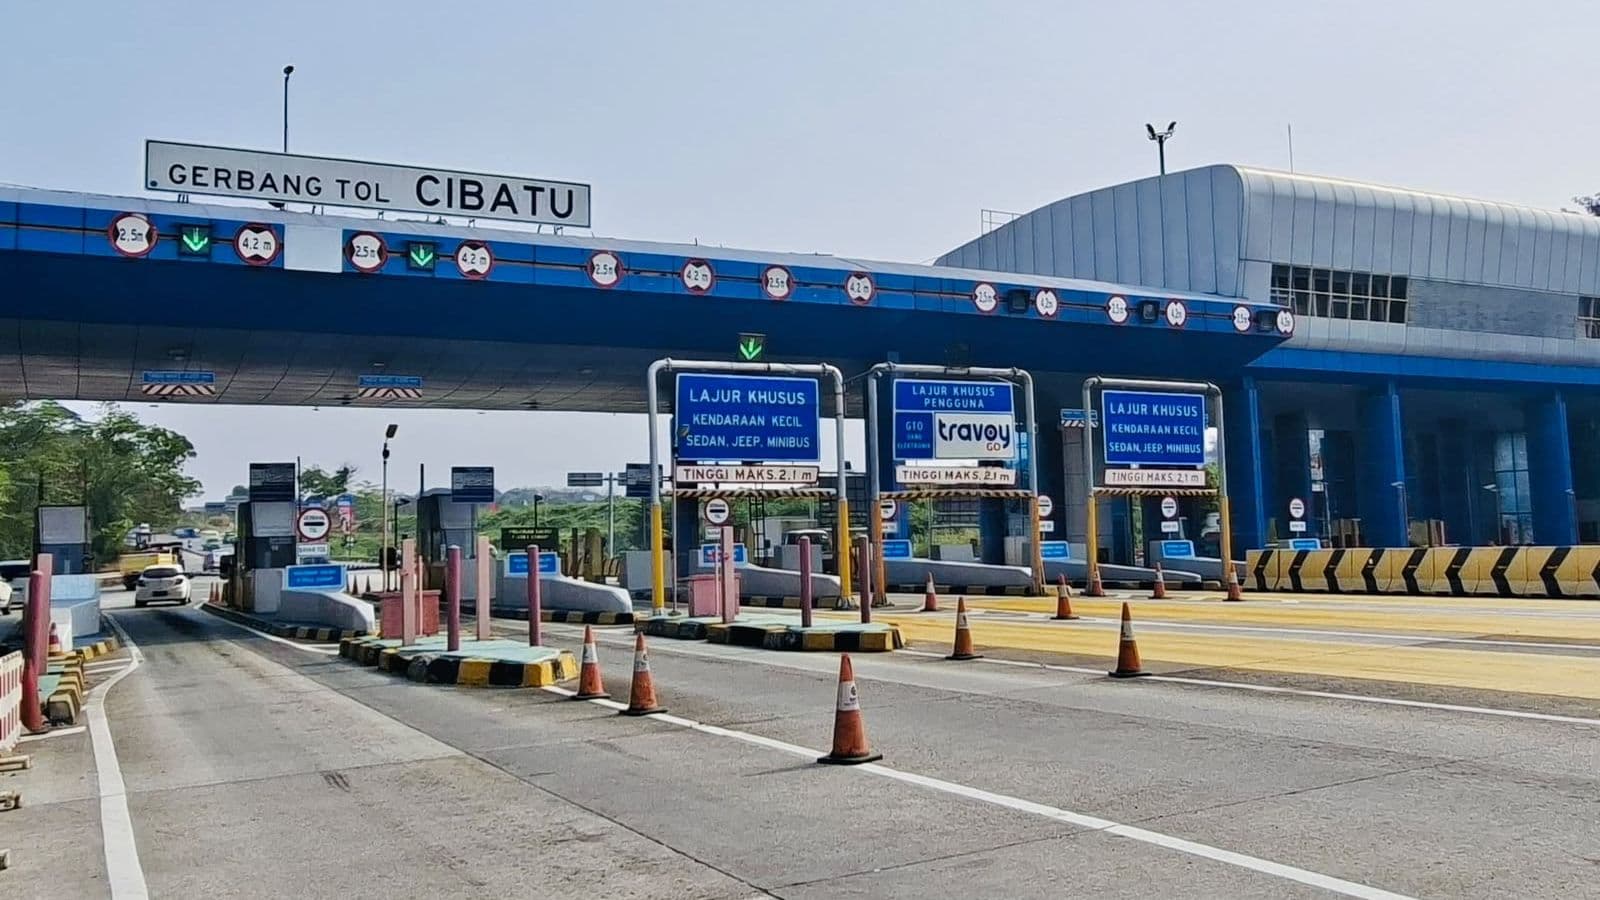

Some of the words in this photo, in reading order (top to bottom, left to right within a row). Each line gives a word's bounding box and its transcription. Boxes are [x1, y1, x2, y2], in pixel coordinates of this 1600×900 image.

[169, 164, 322, 196] GERBANG
[336, 179, 390, 203] TOL
[415, 174, 574, 219] CIBATU
[689, 388, 741, 403] LAJUR
[748, 389, 806, 405] KHUSUS
[912, 385, 948, 396] LAJUR
[952, 386, 995, 397] KHUSUS
[924, 398, 985, 409] PENGGUNA
[1110, 402, 1148, 415] LAJUR
[1152, 404, 1198, 417] KHUSUS
[692, 413, 765, 426] KENDARAAN
[771, 415, 803, 427] KECIL
[905, 420, 924, 431] GTO
[938, 418, 1010, 449] travoy
[1111, 423, 1171, 434] KENDARAAN
[1173, 425, 1199, 436] KECIL
[767, 437, 810, 448] MINIBUS
[986, 443, 1002, 451] GO
[1166, 443, 1201, 454] MINIBUS
[683, 468, 729, 480] TINGGI
[801, 471, 812, 481] m
[902, 470, 941, 480] TINGGI
[999, 473, 1010, 481] m
[1111, 472, 1144, 481] TINGGI
[1191, 474, 1199, 482] m
